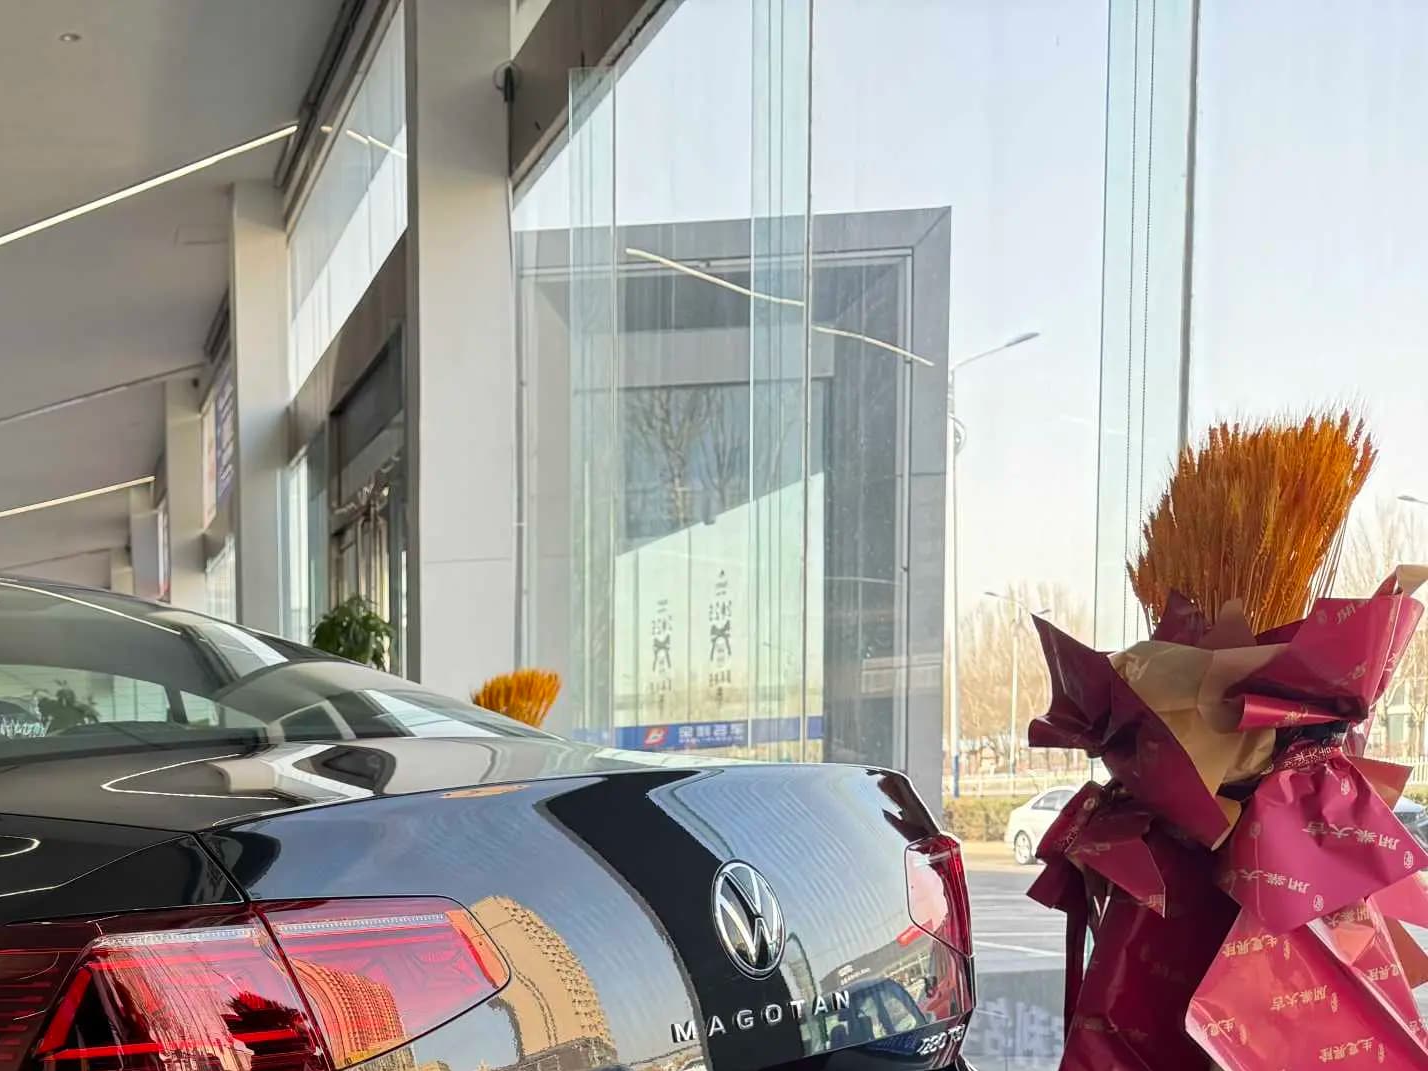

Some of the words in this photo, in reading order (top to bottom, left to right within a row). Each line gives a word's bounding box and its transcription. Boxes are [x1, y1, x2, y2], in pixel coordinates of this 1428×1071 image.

[1324, 905, 1373, 929] 開業大
[671, 990, 851, 1043] MAGOTAN
